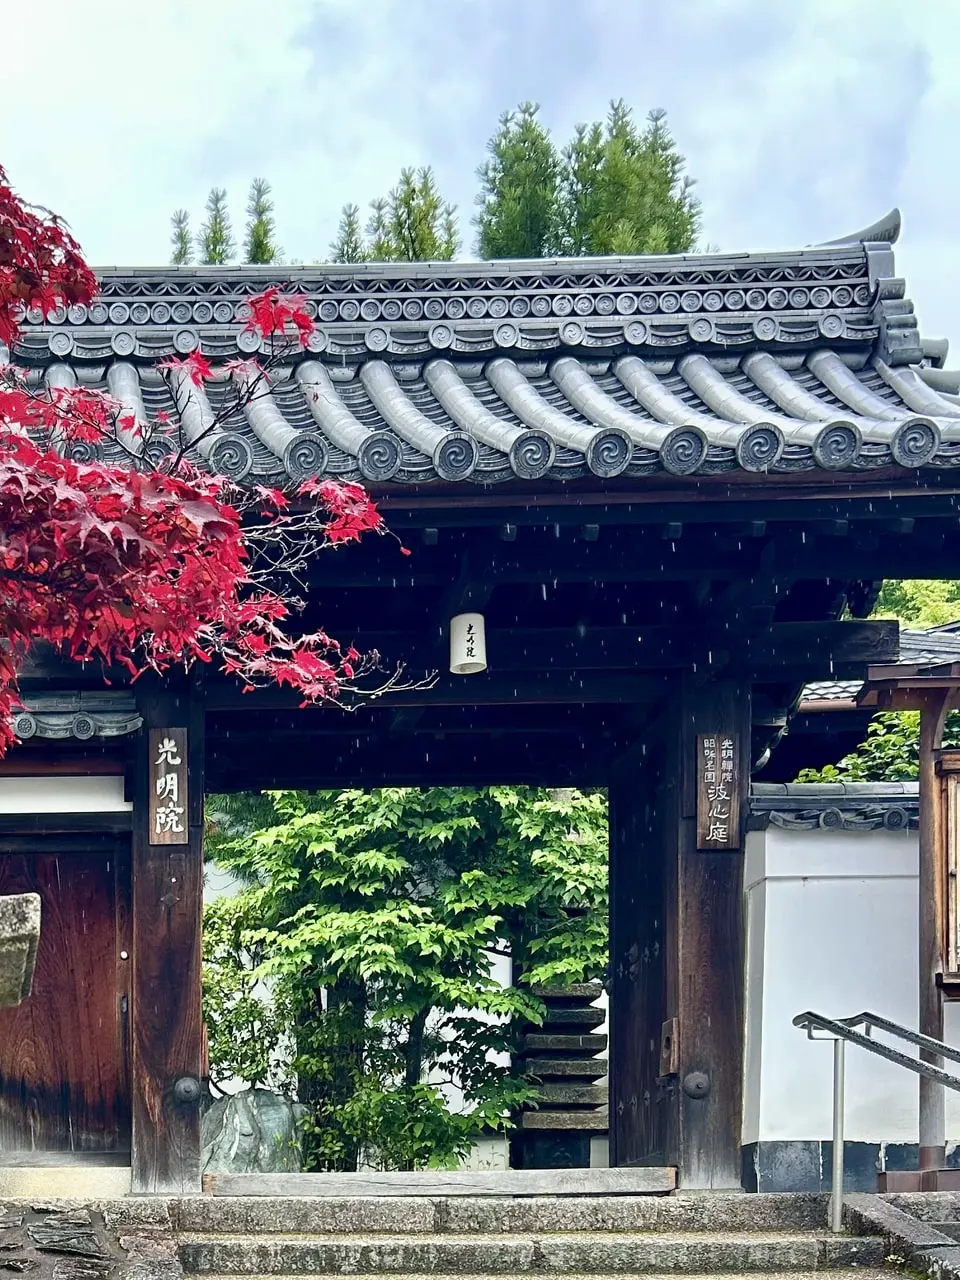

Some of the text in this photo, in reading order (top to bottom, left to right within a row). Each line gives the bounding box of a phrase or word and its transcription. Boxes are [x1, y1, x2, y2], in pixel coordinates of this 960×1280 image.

[154, 737, 185, 834] 光明院
[706, 783, 731, 843] 波心庭
